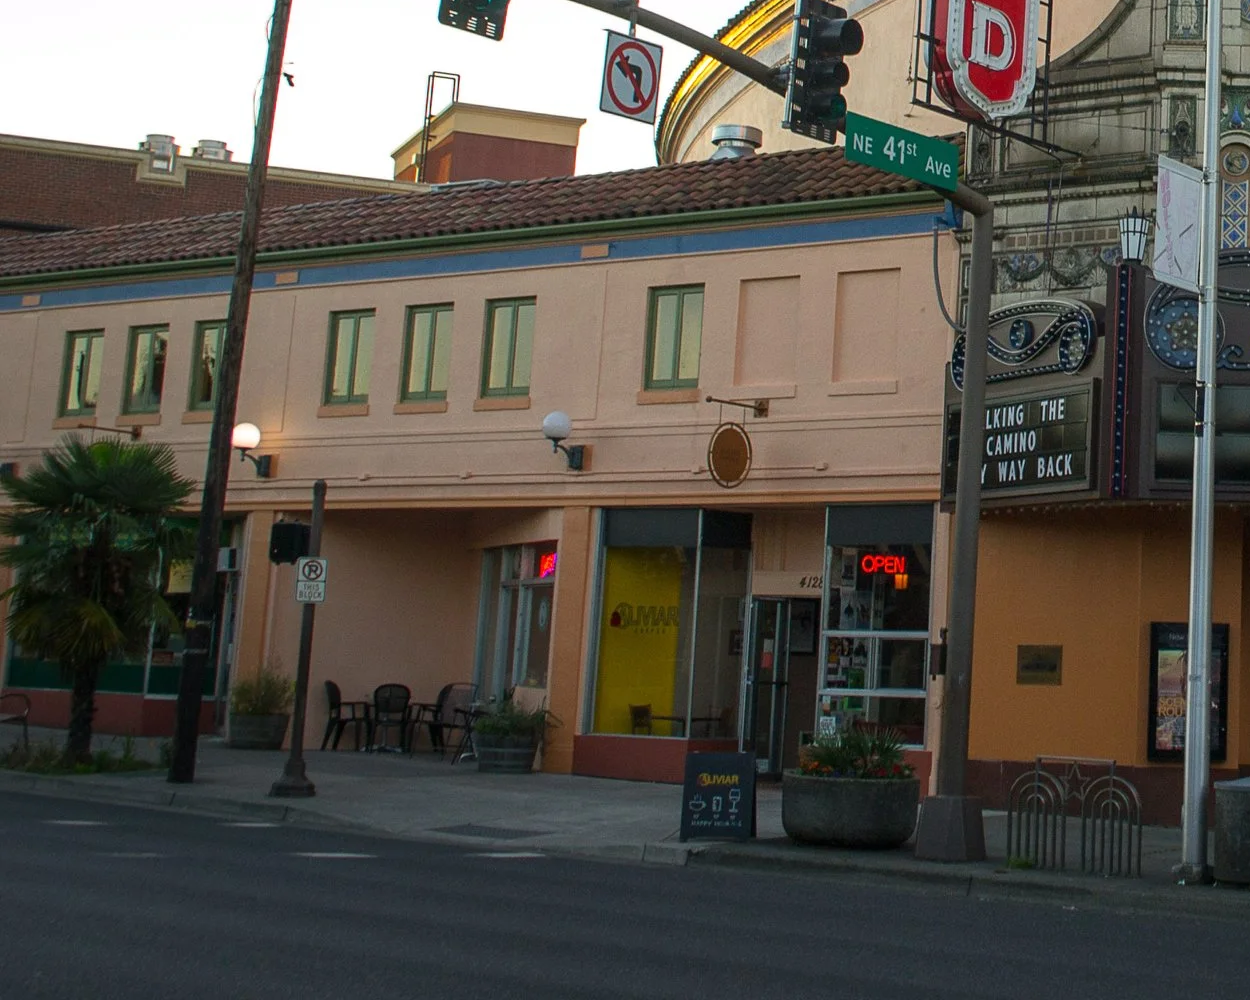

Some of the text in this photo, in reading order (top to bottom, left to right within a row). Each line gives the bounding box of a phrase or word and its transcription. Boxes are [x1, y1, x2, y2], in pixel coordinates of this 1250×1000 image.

[853, 132, 952, 178] NE 41st Ave
[985, 398, 1065, 430] LKING THE
[986, 430, 1036, 456] CAMINO
[998, 459, 1026, 482] WAY
[1037, 454, 1072, 478] BACK
[861, 553, 906, 575] OPEN
[298, 590, 322, 600] BLOCK
[303, 583, 319, 591] THIS
[1158, 695, 1186, 707] SCEN
[1158, 705, 1184, 717] ROU
